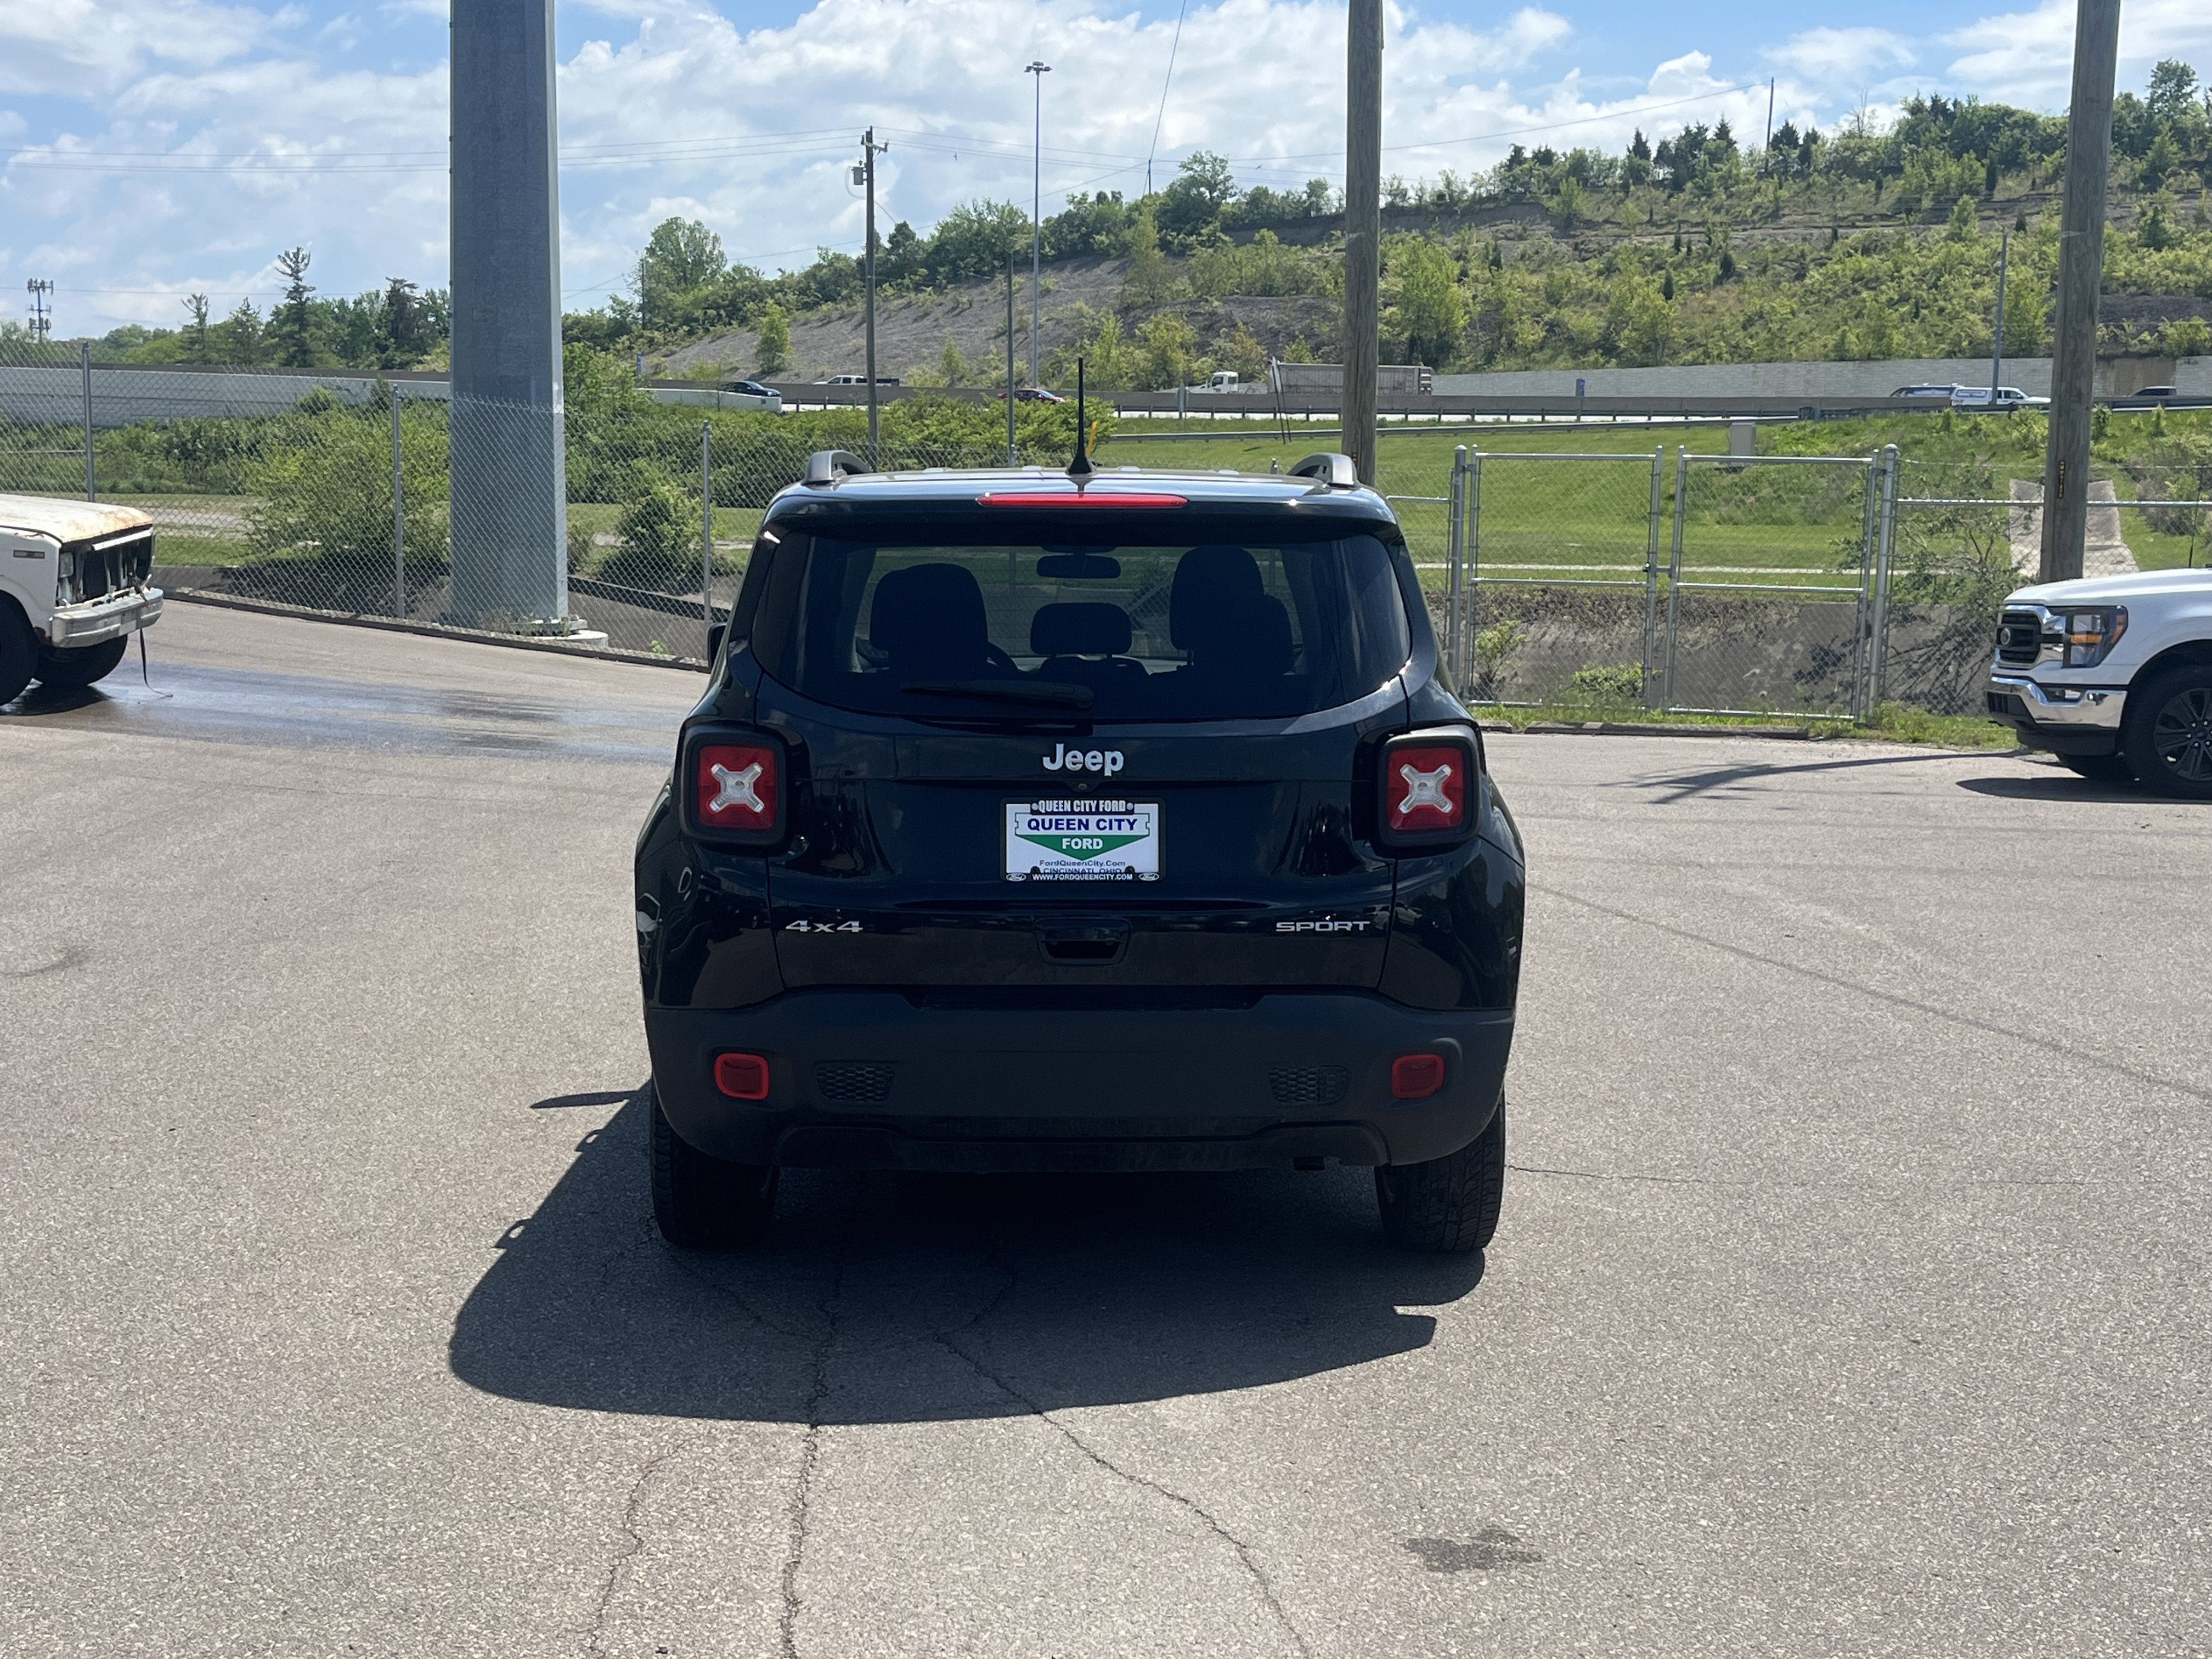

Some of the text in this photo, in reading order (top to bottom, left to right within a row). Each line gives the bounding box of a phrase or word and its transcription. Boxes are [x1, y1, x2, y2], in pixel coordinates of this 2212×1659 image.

[1042, 743, 1124, 777] Jeep
[1039, 800, 1126, 813] QUEEN CITY FORD
[1028, 818, 1138, 831] QUEEN CITY
[1062, 838, 1103, 850] FORD
[786, 920, 863, 933] 4x4
[1276, 921, 1370, 932] SPORT
